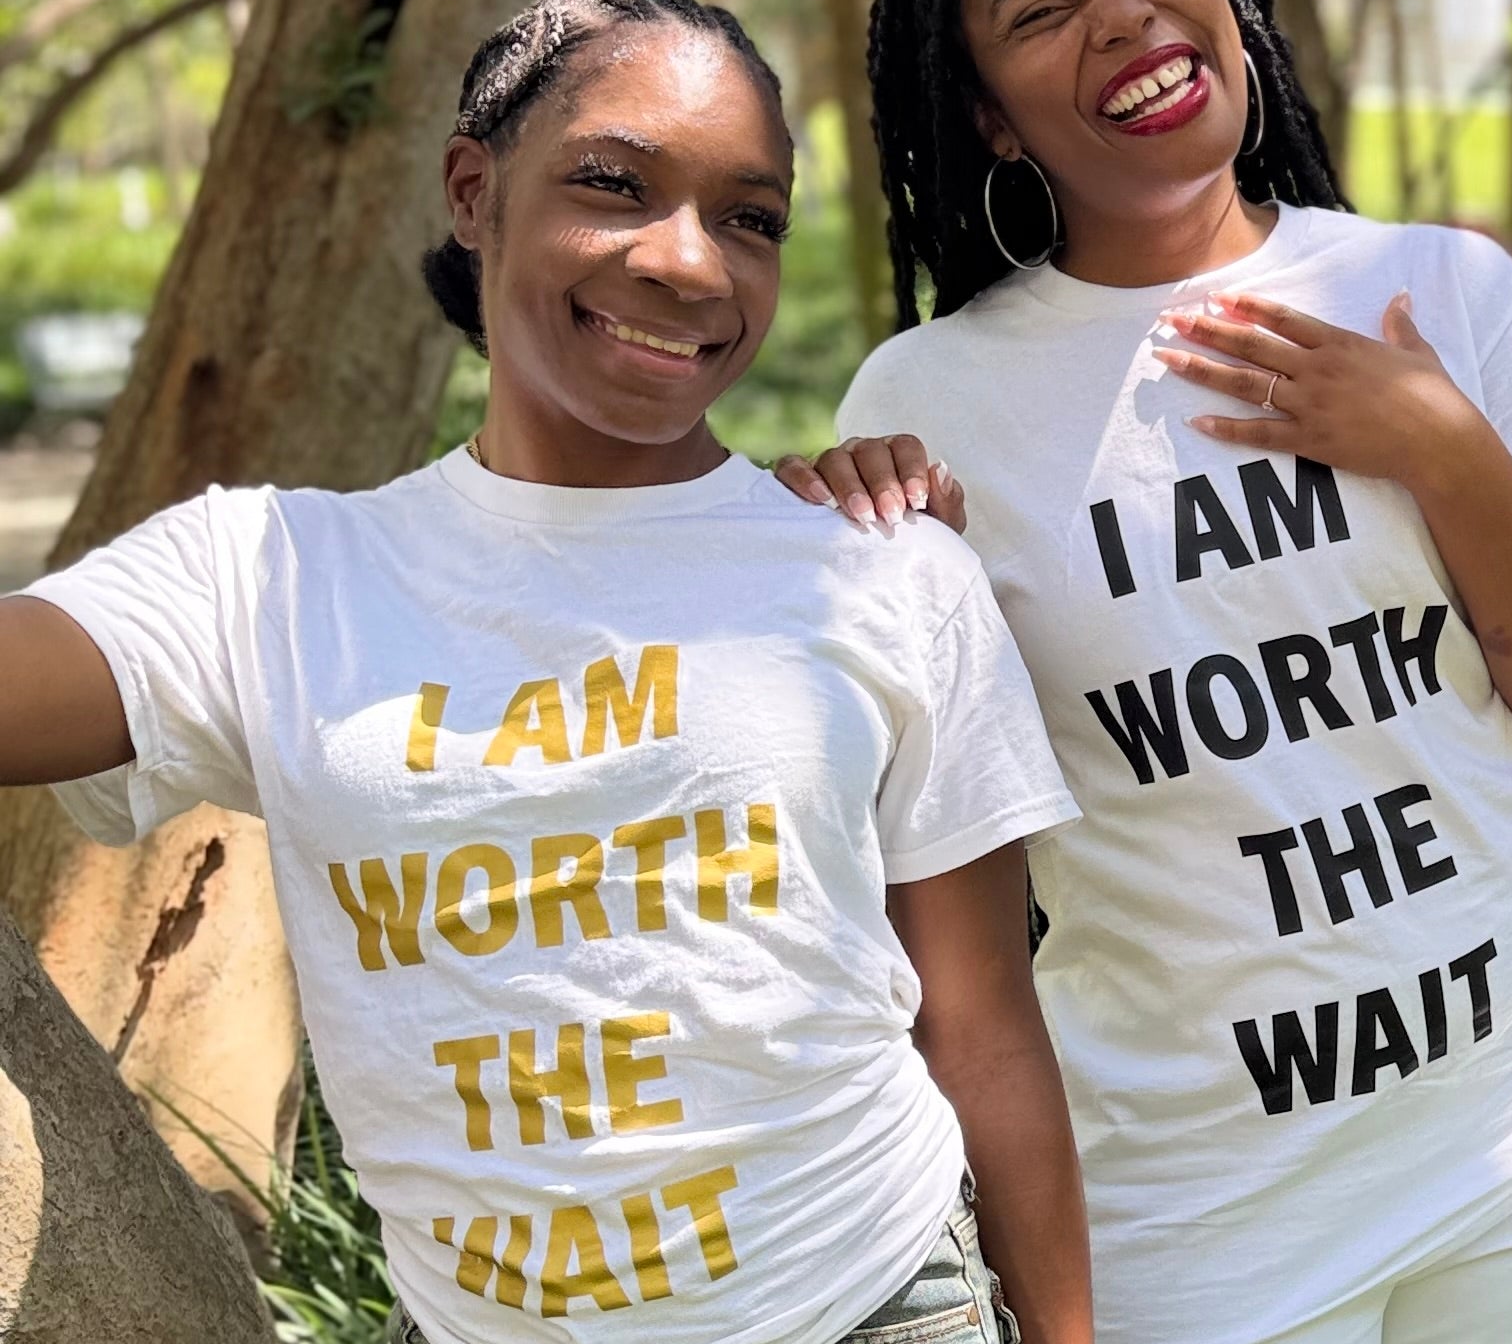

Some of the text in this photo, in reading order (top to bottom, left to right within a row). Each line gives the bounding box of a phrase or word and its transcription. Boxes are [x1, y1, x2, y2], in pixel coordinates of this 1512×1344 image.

[1089, 455, 1350, 598] I AM
[405, 644, 679, 772] I AM
[1085, 604, 1449, 785] WORTH
[328, 803, 779, 972] WORTH
[1237, 784, 1459, 937] THE
[434, 1011, 684, 1152] THE
[1233, 938, 1497, 1116] WAIT
[433, 1165, 739, 1319] WAIT
